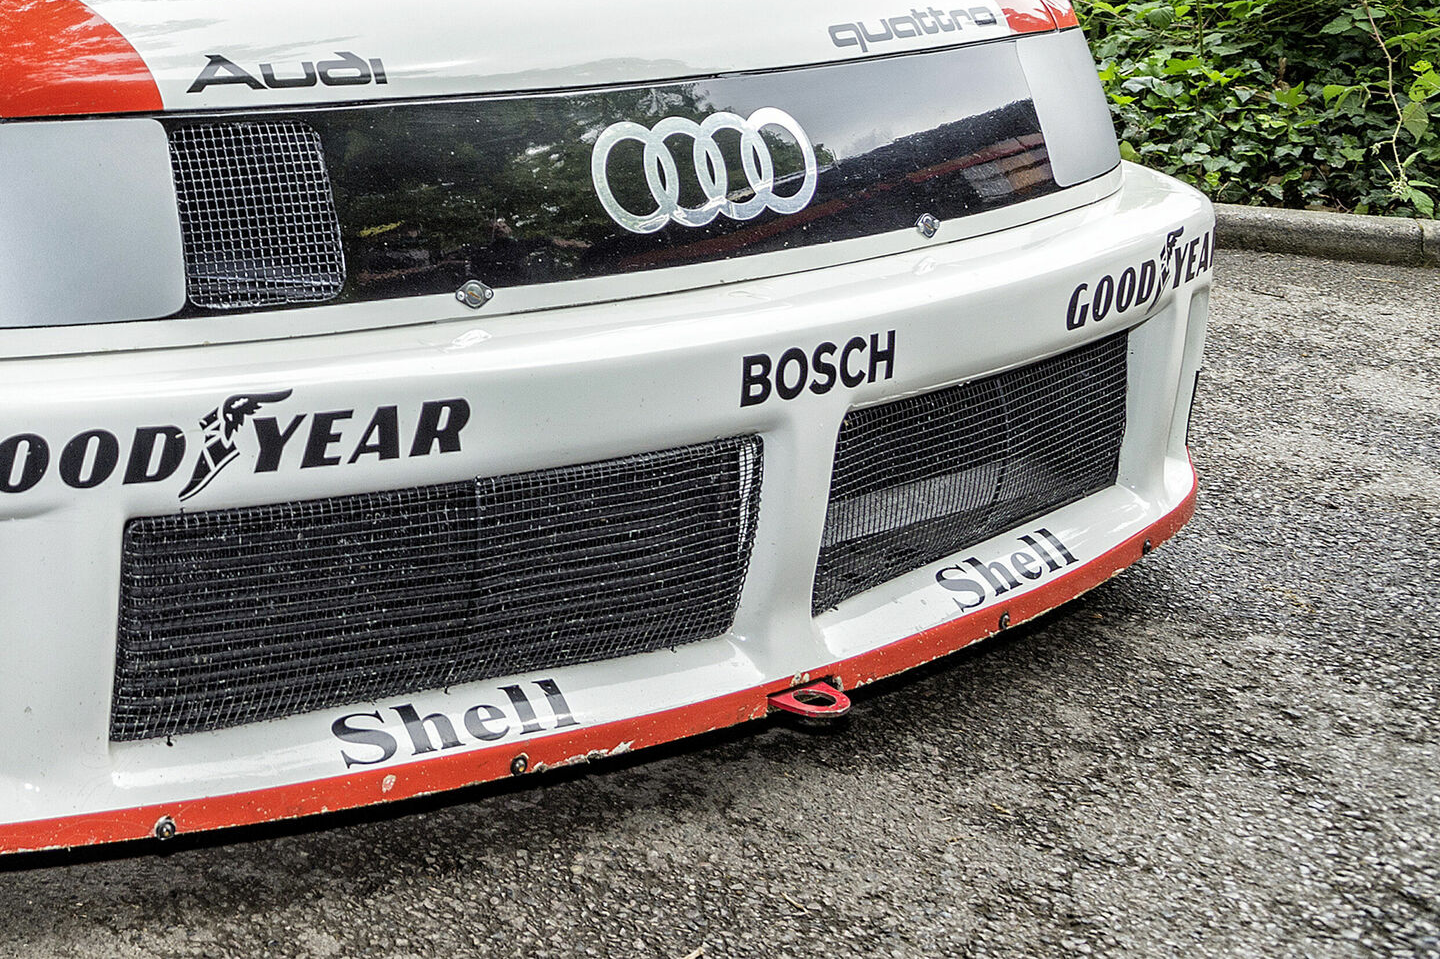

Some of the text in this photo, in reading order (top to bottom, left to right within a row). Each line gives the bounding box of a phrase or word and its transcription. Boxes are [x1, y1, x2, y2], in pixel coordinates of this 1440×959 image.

[828, 6, 998, 53] quattro
[186, 51, 388, 94] Audi
[1066, 226, 1216, 331] GOODYEA
[740, 330, 896, 408] BOSCH
[935, 528, 1080, 613] Shell
[331, 678, 581, 770] Shell
